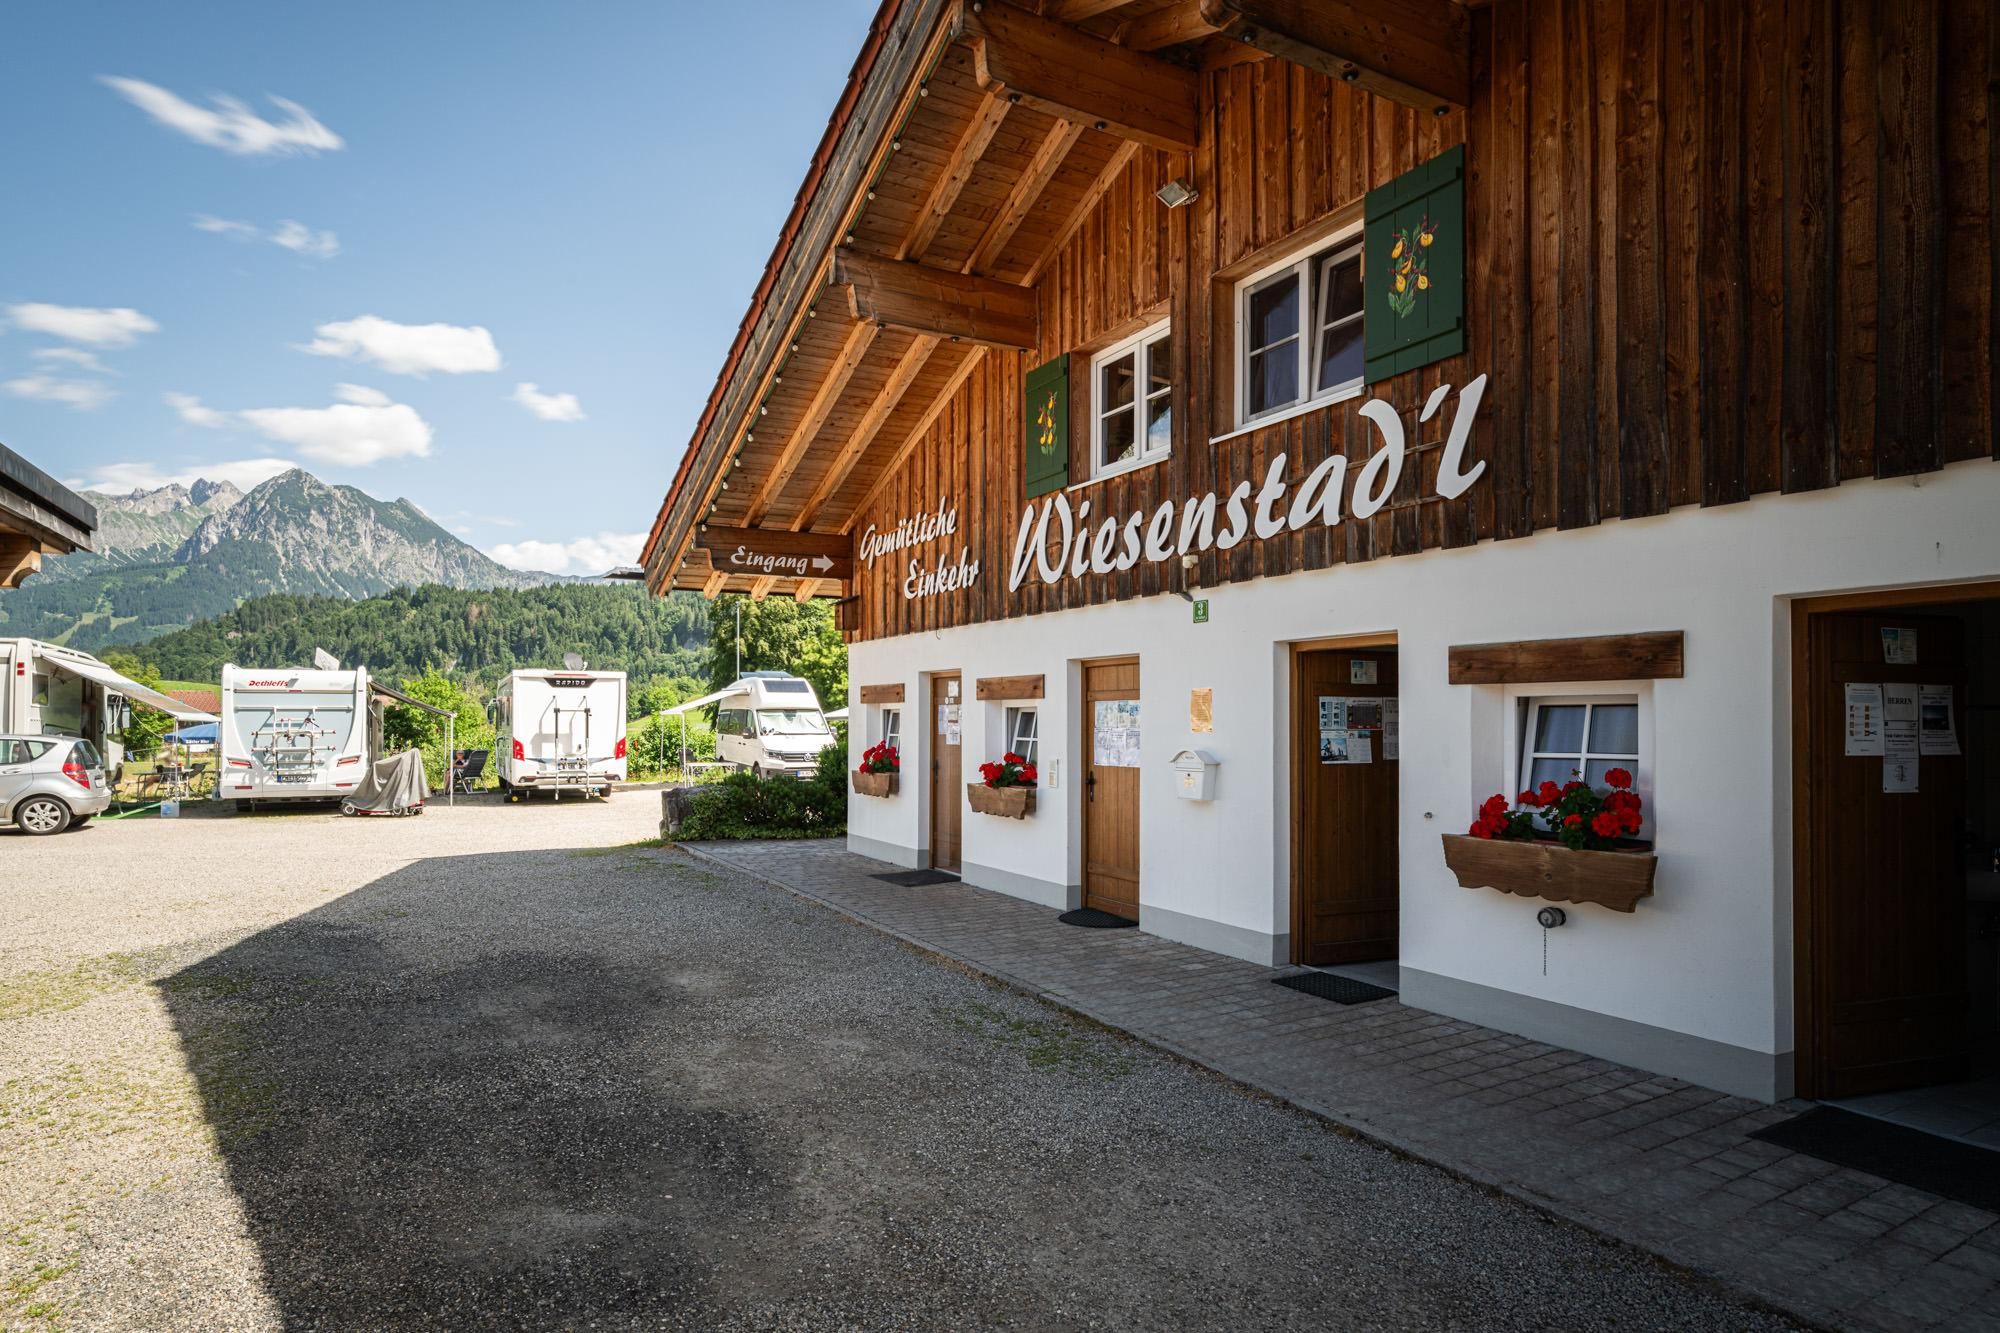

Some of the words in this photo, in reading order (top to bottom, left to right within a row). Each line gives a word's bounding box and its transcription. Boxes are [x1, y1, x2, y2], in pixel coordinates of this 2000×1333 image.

[1009, 373, 1487, 592] Wiesenstad'l
[859, 496, 957, 569] Gemütliche
[730, 546, 808, 575] Eingang
[903, 546, 980, 599] Einkehr
[1198, 602, 1204, 616] 3
